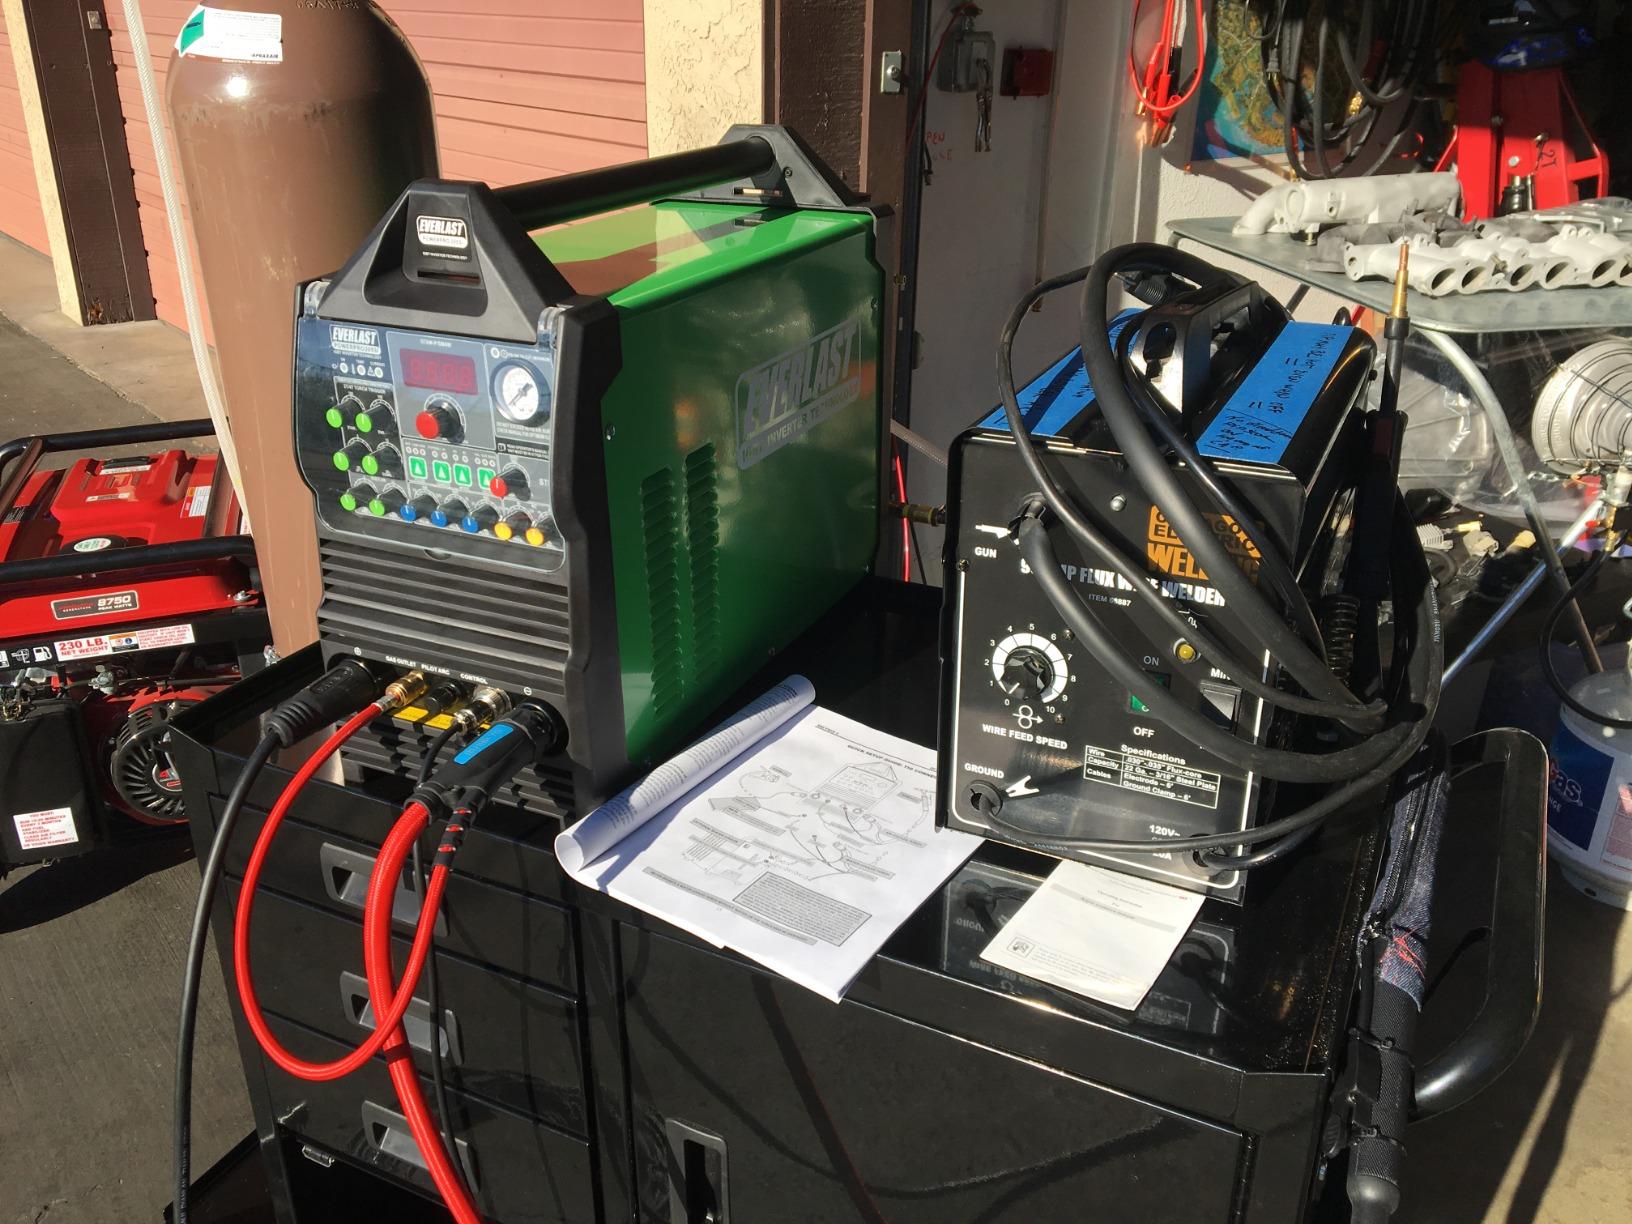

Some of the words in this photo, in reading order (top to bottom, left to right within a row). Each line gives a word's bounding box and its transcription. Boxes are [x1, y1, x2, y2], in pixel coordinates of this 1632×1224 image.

[420, 218, 463, 236] EVERLAST
[333, 327, 377, 345] EVERLAST
[744, 322, 859, 441] EVERLAST
[974, 546, 997, 558] GUN
[1080, 567, 1115, 588] FLUX
[98, 595, 131, 607] 8750
[1088, 593, 1107, 602] ITEM
[59, 640, 83, 651] 230
[87, 637, 108, 647] LB.
[61, 649, 76, 657] NET
[78, 645, 108, 654] WEIGHT
[385, 655, 397, 664] GAS
[397, 658, 417, 668] OUTLET
[1143, 655, 1160, 666] ON
[421, 663, 438, 673] PILOT
[438, 667, 450, 676] ARC
[460, 673, 488, 685] CONTROL
[1046, 706, 1056, 714] 10
[982, 724, 1007, 736] WIRE
[1008, 730, 1034, 742] FEED
[1035, 735, 1068, 750] SPEED
[1133, 726, 1155, 738] OFF
[1121, 744, 1186, 765] Specifications
[964, 762, 1004, 779] GROUND
[1088, 748, 1105, 757] Wire
[1166, 763, 1202, 779] Flux-core
[1086, 768, 1112, 779] Cables
[1124, 772, 1159, 786] Electrode
[1087, 756, 1119, 769] Capacity
[1125, 764, 1134, 772] 22
[1176, 776, 1196, 786] Steel
[1197, 780, 1217, 791] Plate
[1123, 780, 1151, 792] Ground
[1152, 787, 1176, 799] Clamp
[1149, 824, 1181, 837] 120V~
